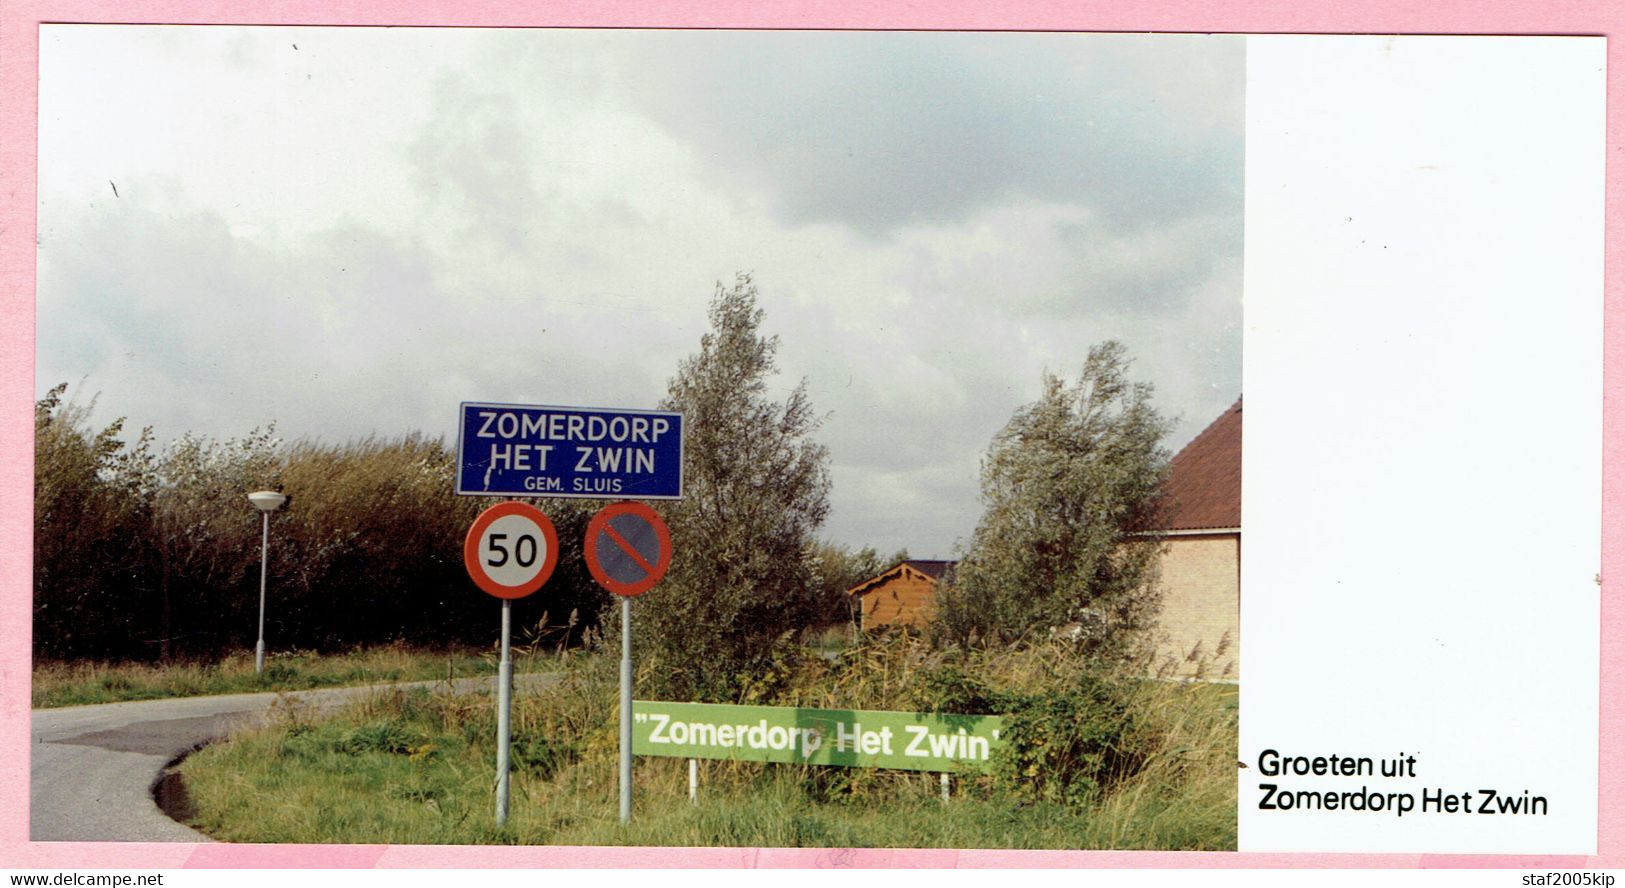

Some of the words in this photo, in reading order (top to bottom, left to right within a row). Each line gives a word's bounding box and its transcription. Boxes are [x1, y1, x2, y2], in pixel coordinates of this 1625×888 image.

[477, 412, 669, 443] ZOMERDORP
[490, 443, 553, 471] HET
[574, 447, 655, 474] ZWIN
[524, 476, 564, 491] GEM.
[573, 478, 622, 492] SLUIS
[487, 534, 537, 567] 50
[837, 721, 893, 755] Het
[1258, 749, 1373, 777] Groeten
[1380, 752, 1417, 777] uit
[1258, 784, 1415, 817] Zomerdorp
[1422, 788, 1472, 813] Het
[1478, 790, 1548, 815] Zwin
